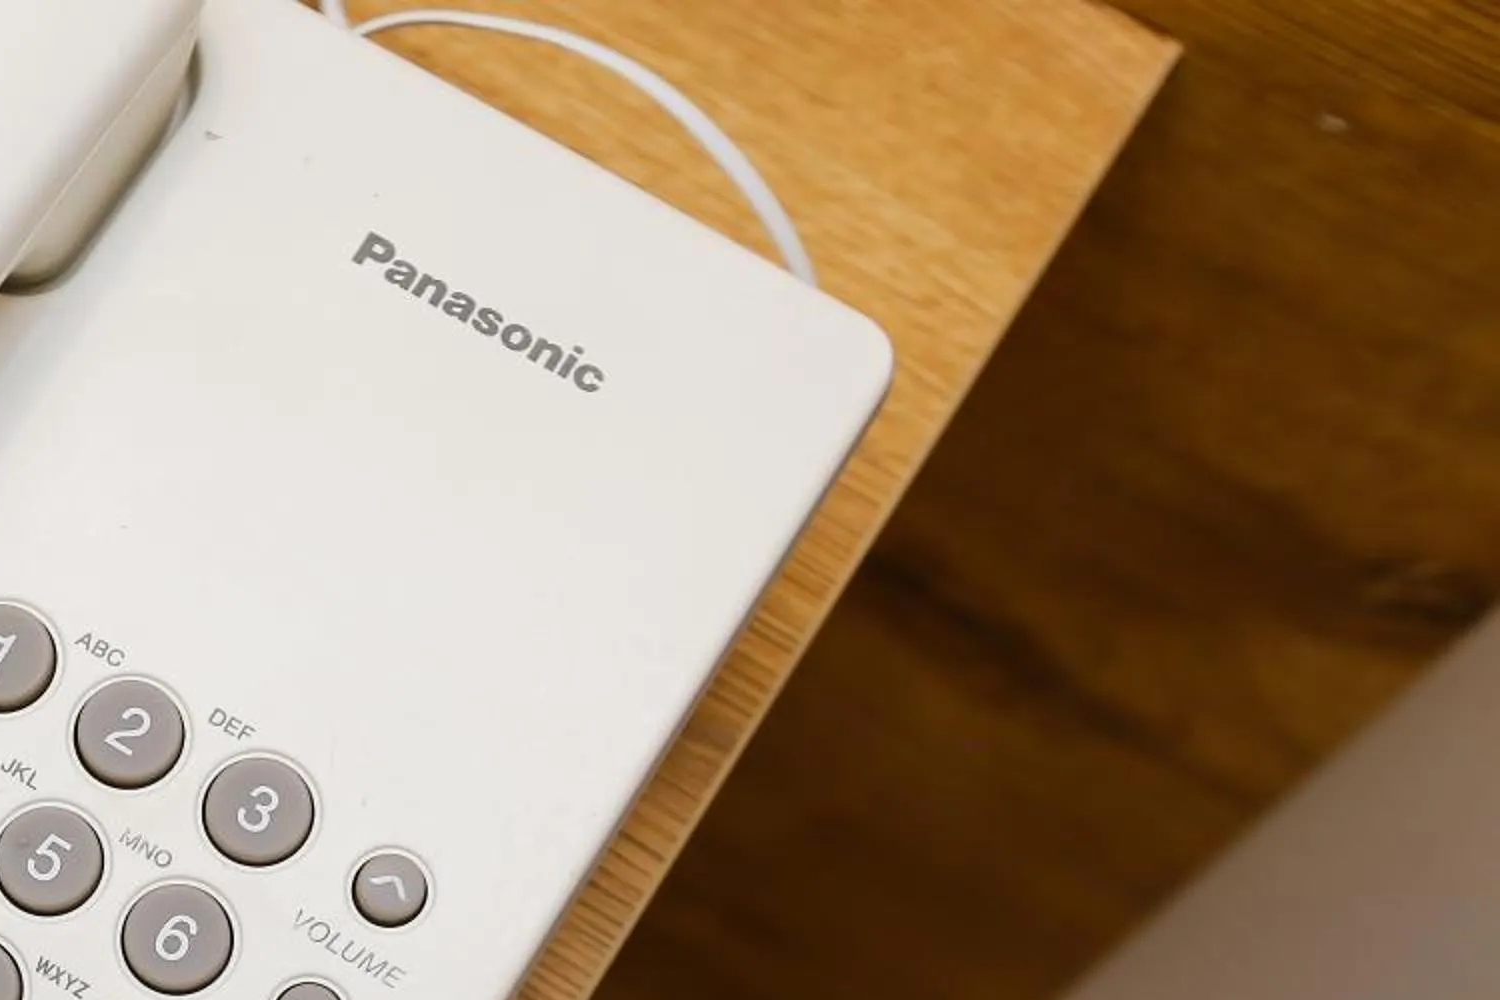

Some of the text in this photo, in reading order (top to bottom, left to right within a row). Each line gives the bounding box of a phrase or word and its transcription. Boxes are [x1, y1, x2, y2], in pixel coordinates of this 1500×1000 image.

[351, 230, 605, 393] Panasonic
[75, 633, 126, 668] ABC
[105, 706, 151, 756] 2
[208, 707, 257, 742] DEF
[0, 758, 39, 790] JKL
[236, 785, 280, 833] 3
[27, 833, 73, 881] 5
[118, 828, 173, 869] MNO
[155, 913, 198, 961] 6
[295, 907, 407, 989] VOLUME
[35, 956, 92, 1000] WXYZ
